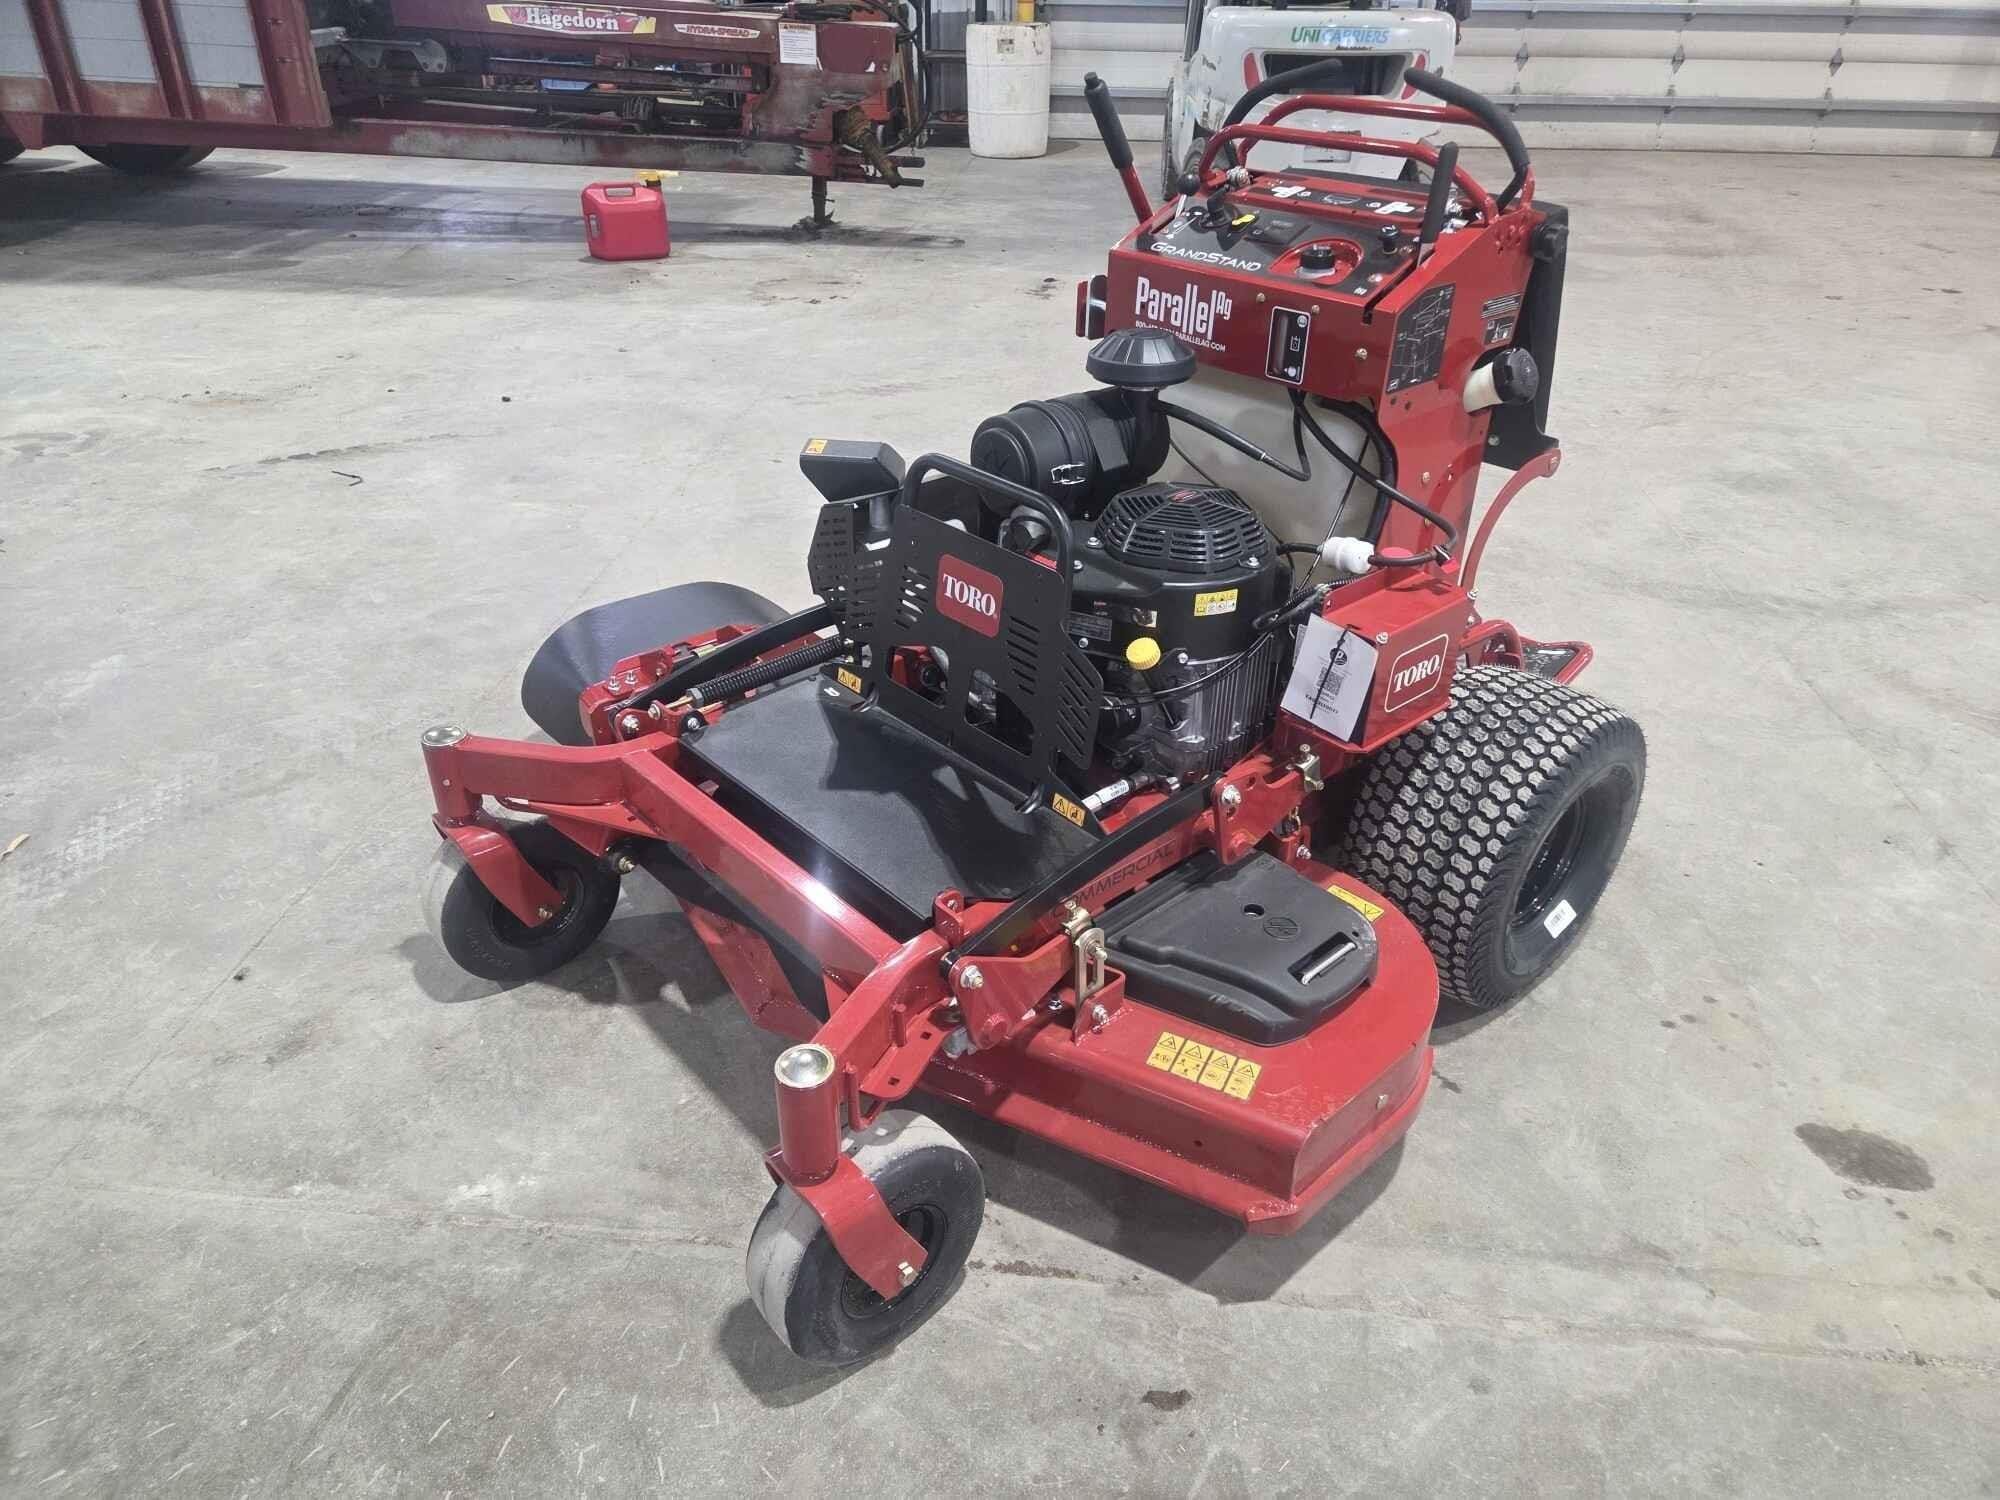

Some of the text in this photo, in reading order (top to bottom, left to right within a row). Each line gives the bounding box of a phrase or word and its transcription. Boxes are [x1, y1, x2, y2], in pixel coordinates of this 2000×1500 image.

[526, 8, 619, 30] Hagedorn
[1135, 276, 1217, 341] Parallel
[943, 573, 996, 617] TORO
[1393, 654, 1440, 693] TORO
